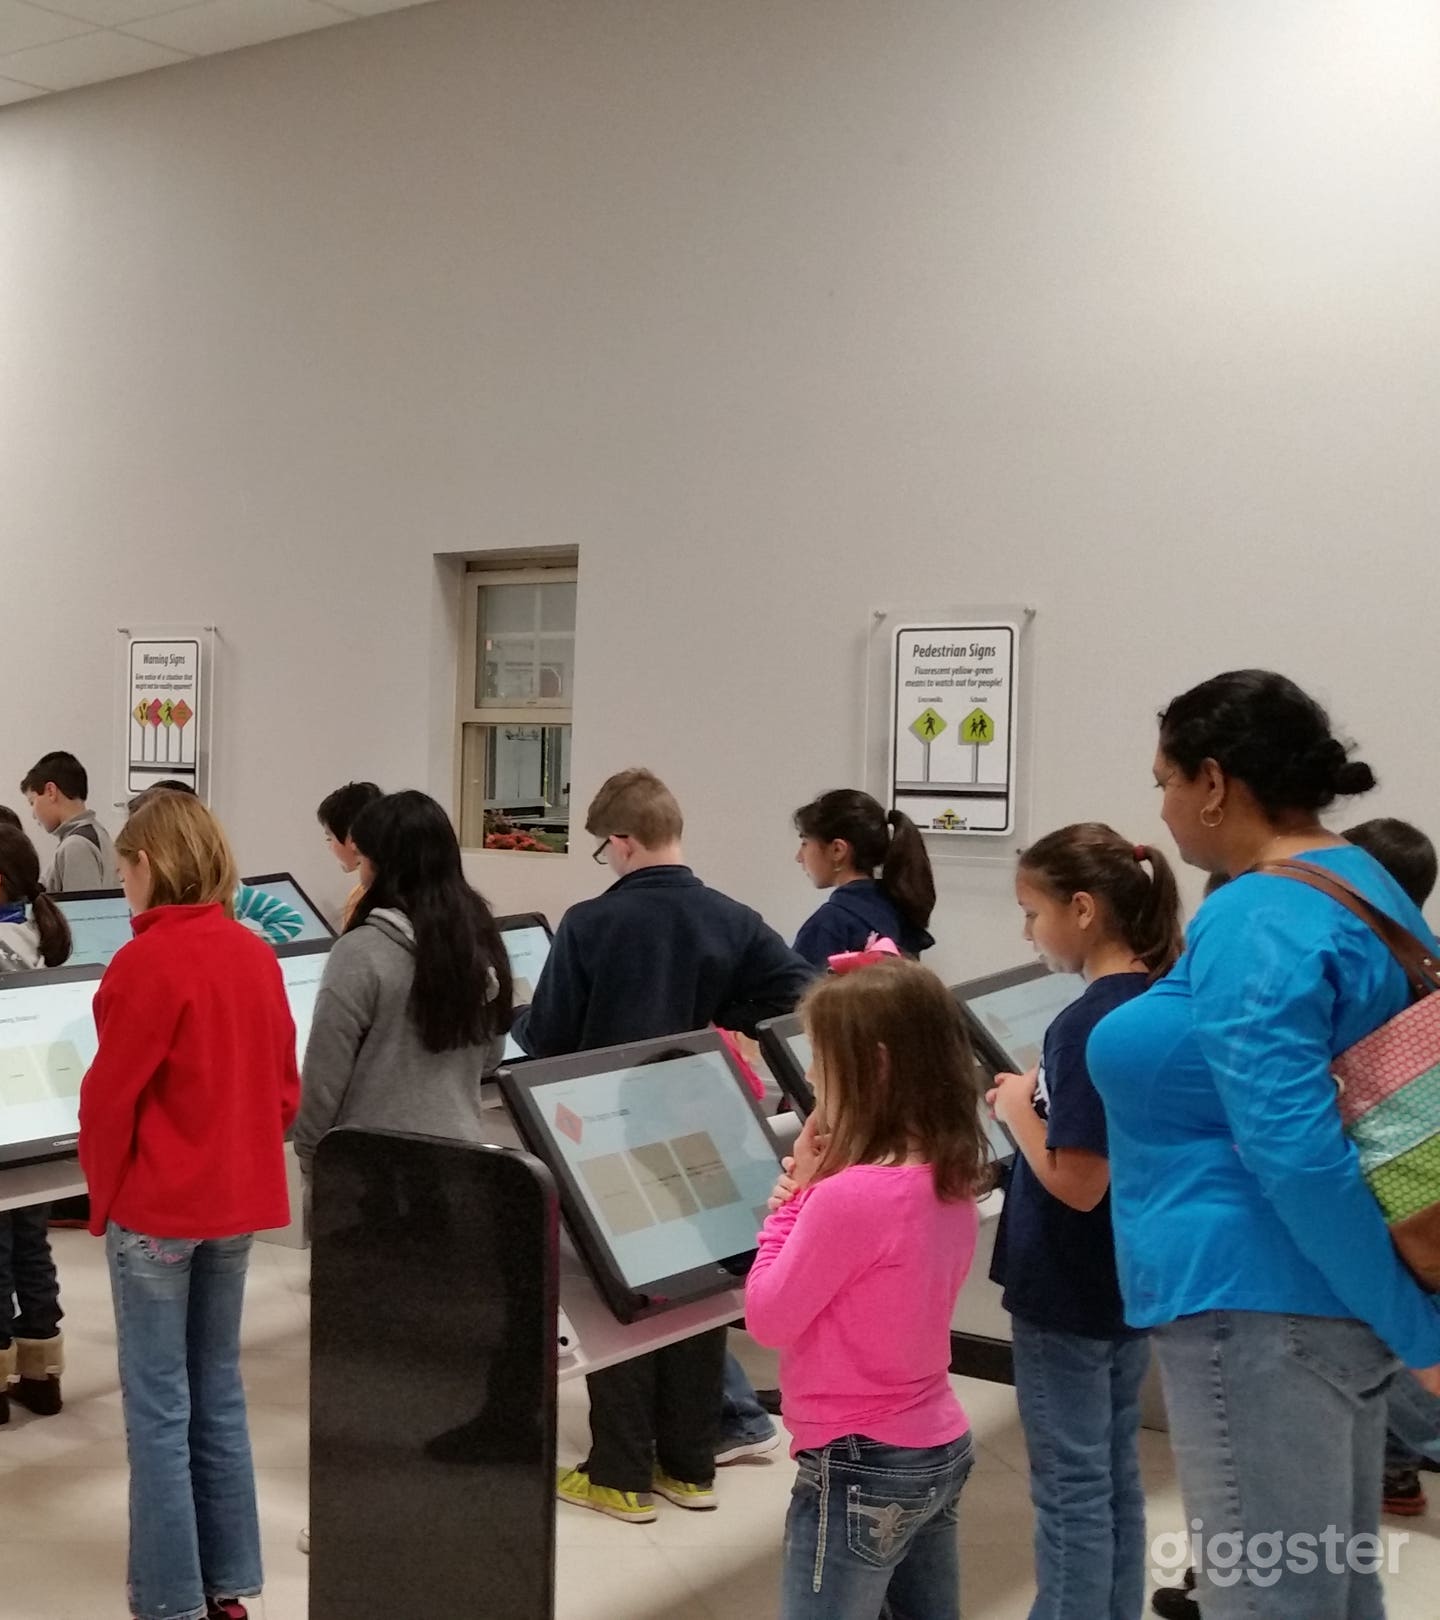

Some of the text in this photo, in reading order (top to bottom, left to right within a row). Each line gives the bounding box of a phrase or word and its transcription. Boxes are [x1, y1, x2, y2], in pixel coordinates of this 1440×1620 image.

[913, 643, 996, 660] Pedestrian Signs
[143, 653, 186, 667] Warning Signs
[914, 666, 994, 676] Fluorescent yellow-green
[905, 677, 1003, 688] means to watch out for people!
